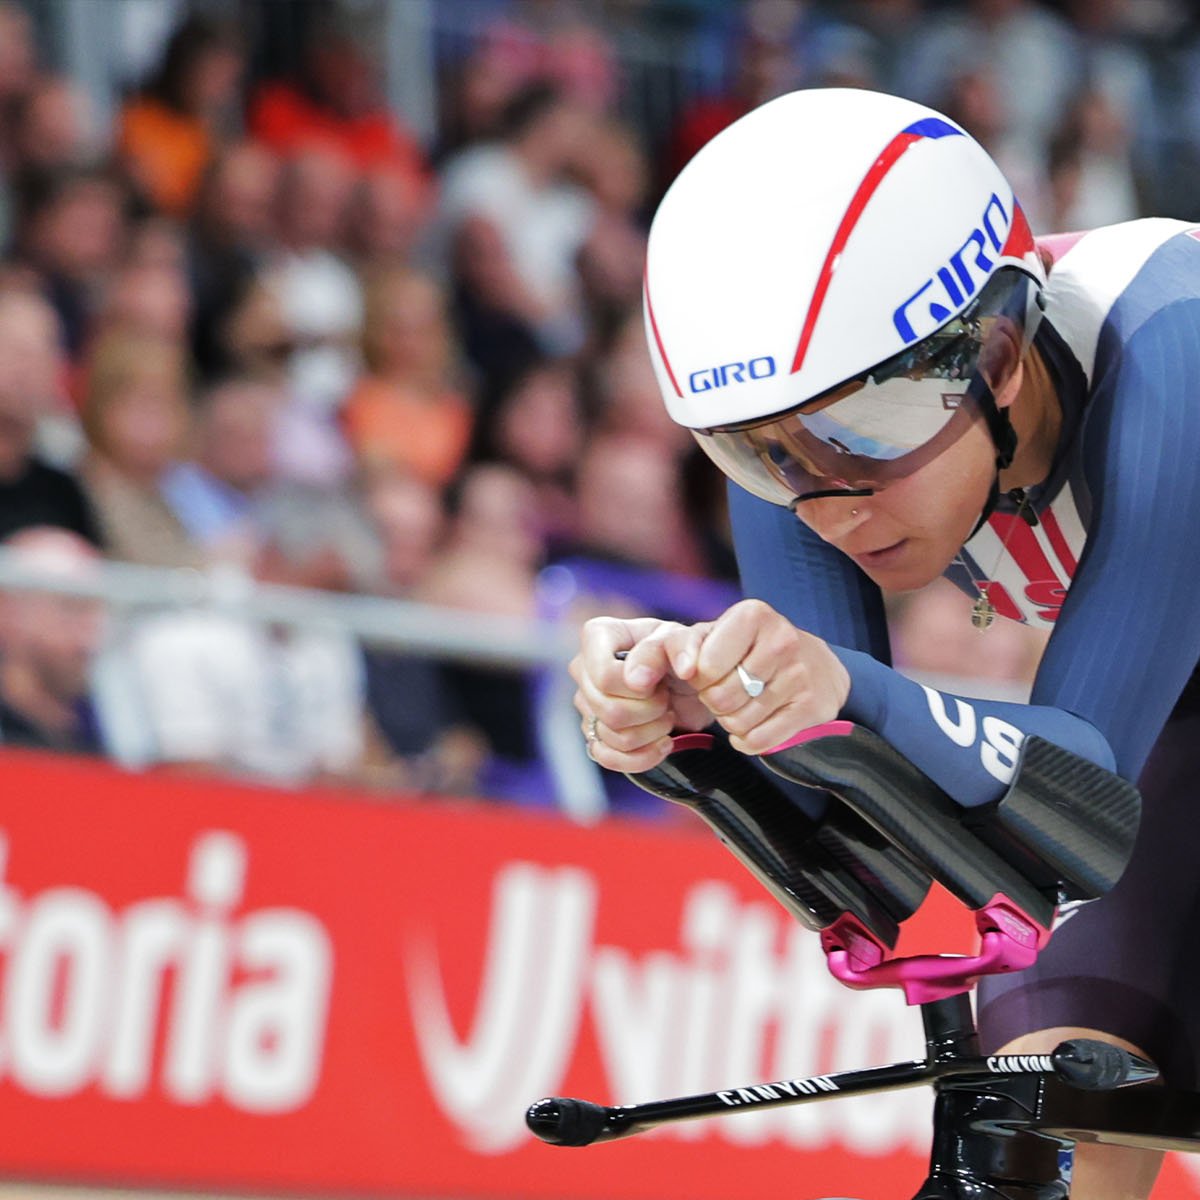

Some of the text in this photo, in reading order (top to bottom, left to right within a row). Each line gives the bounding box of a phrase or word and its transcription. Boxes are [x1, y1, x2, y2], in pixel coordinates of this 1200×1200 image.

[893, 192, 1009, 345] GIRO
[688, 354, 778, 393] GIRO
[597, 880, 936, 1158] vitto
[986, 1055, 1053, 1073] CANYON
[715, 1074, 841, 1106] CANYON
